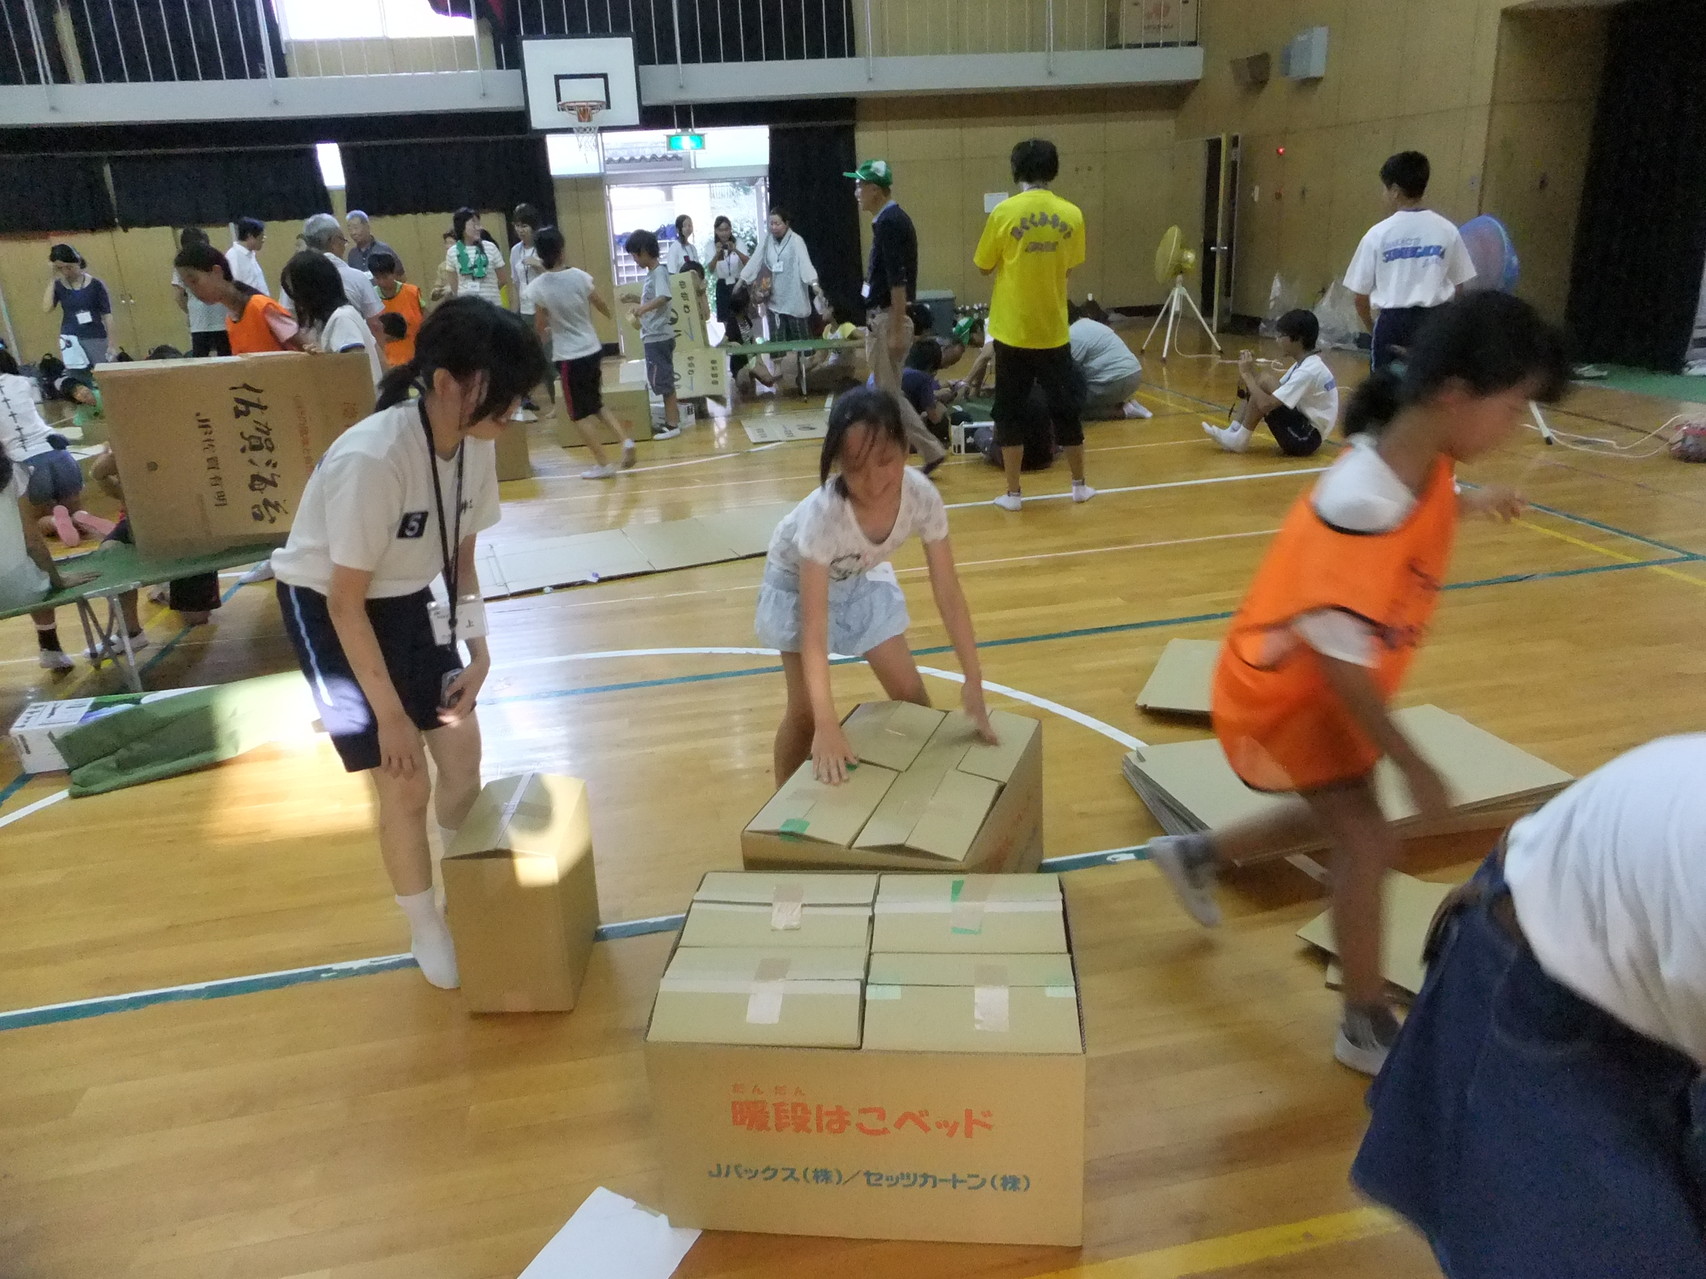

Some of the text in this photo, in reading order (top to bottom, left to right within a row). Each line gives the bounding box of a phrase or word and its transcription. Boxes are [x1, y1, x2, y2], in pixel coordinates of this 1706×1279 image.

[731, 1100, 994, 1138] 暖段はこベッド
